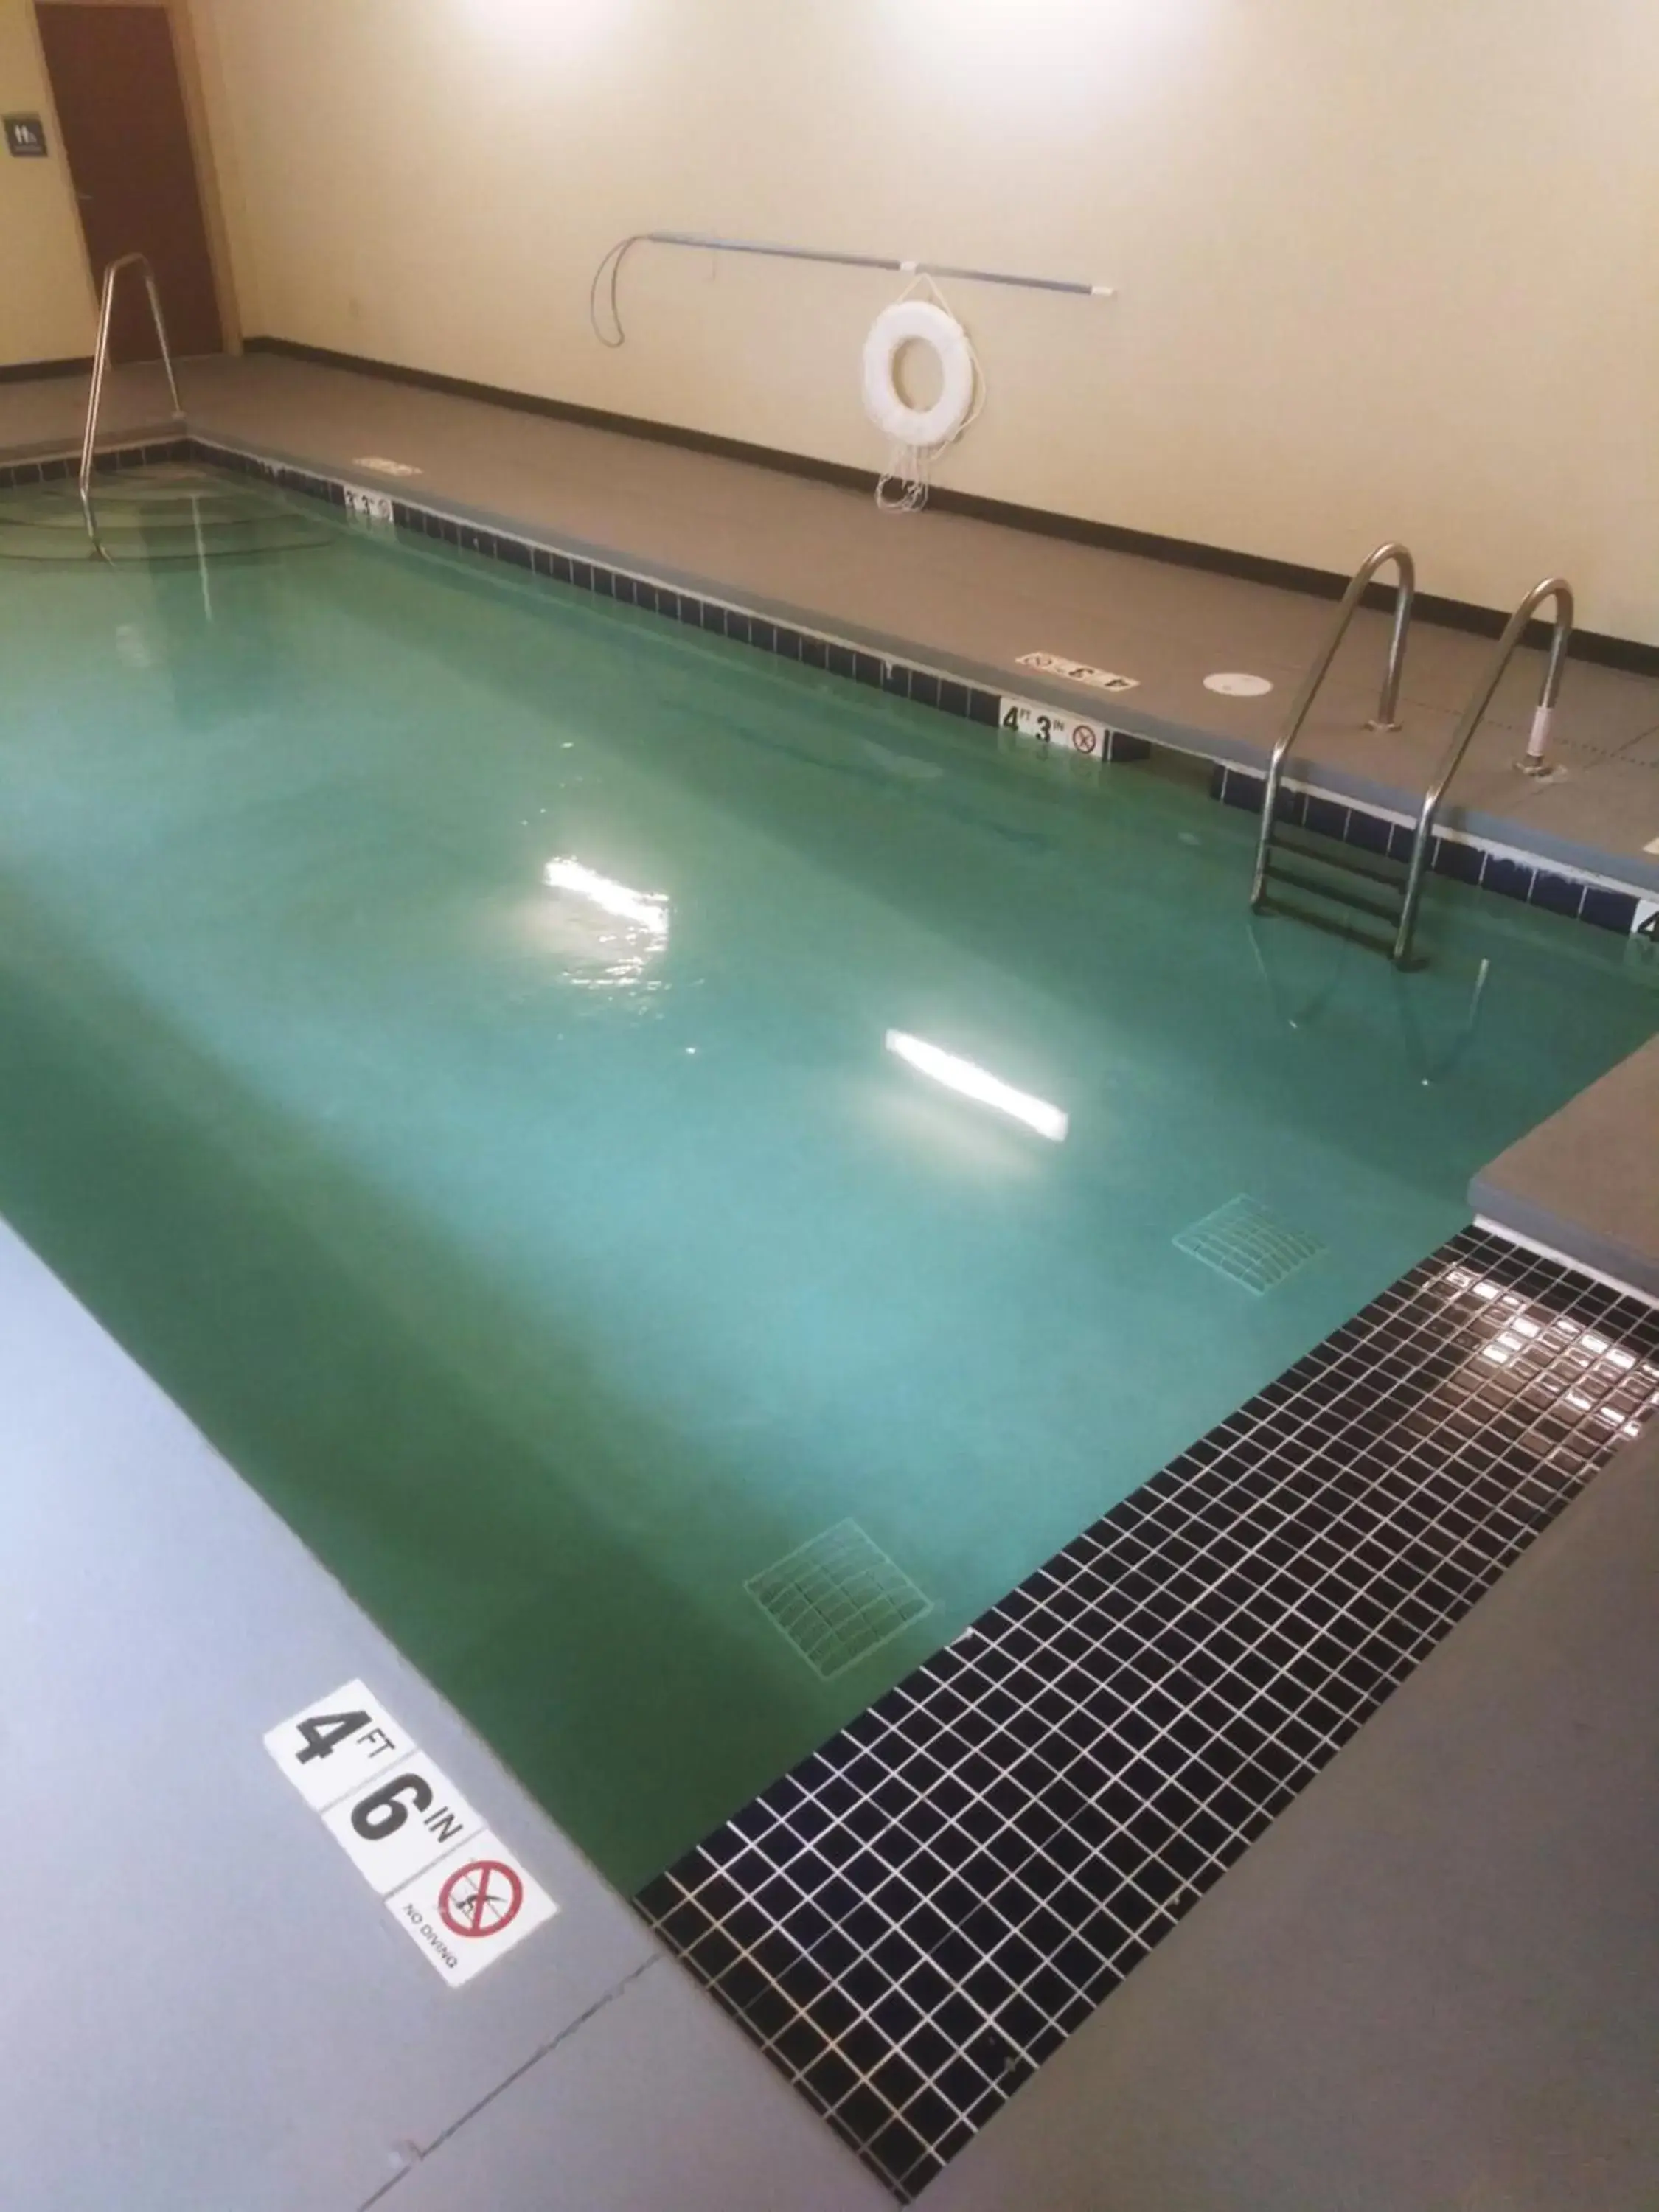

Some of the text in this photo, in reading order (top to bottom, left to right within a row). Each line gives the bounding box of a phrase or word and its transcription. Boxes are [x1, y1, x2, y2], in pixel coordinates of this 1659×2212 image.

[1003, 706, 1031, 731] 4 FT
[1036, 715, 1065, 742] 3 IN
[295, 1710, 396, 1764] 4 FT
[351, 1773, 464, 1843] 6 IN
[403, 1902, 458, 1969] NO DIVING
